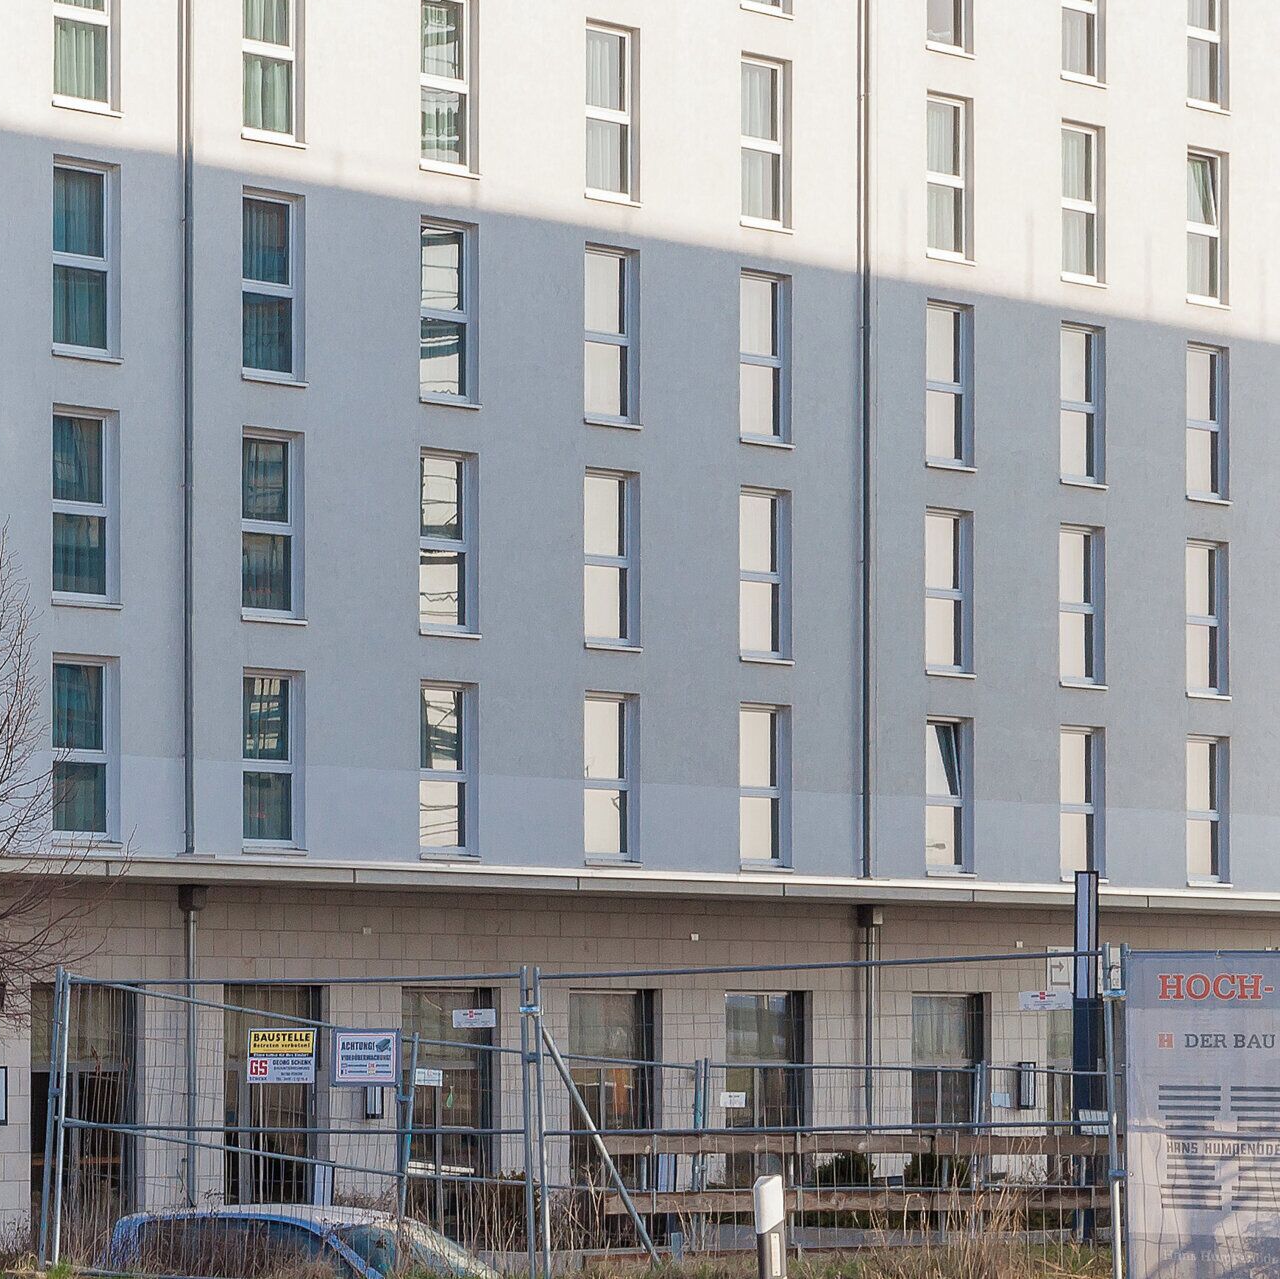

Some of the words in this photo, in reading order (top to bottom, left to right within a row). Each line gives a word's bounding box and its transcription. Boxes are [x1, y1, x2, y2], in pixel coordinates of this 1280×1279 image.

[1158, 972, 1274, 1000] HOCH-
[253, 1032, 311, 1042] BAUSTELLE
[1184, 1032, 1228, 1049] DER
[340, 1041, 376, 1051] ACHTUNG!
[249, 1059, 268, 1076] GS
